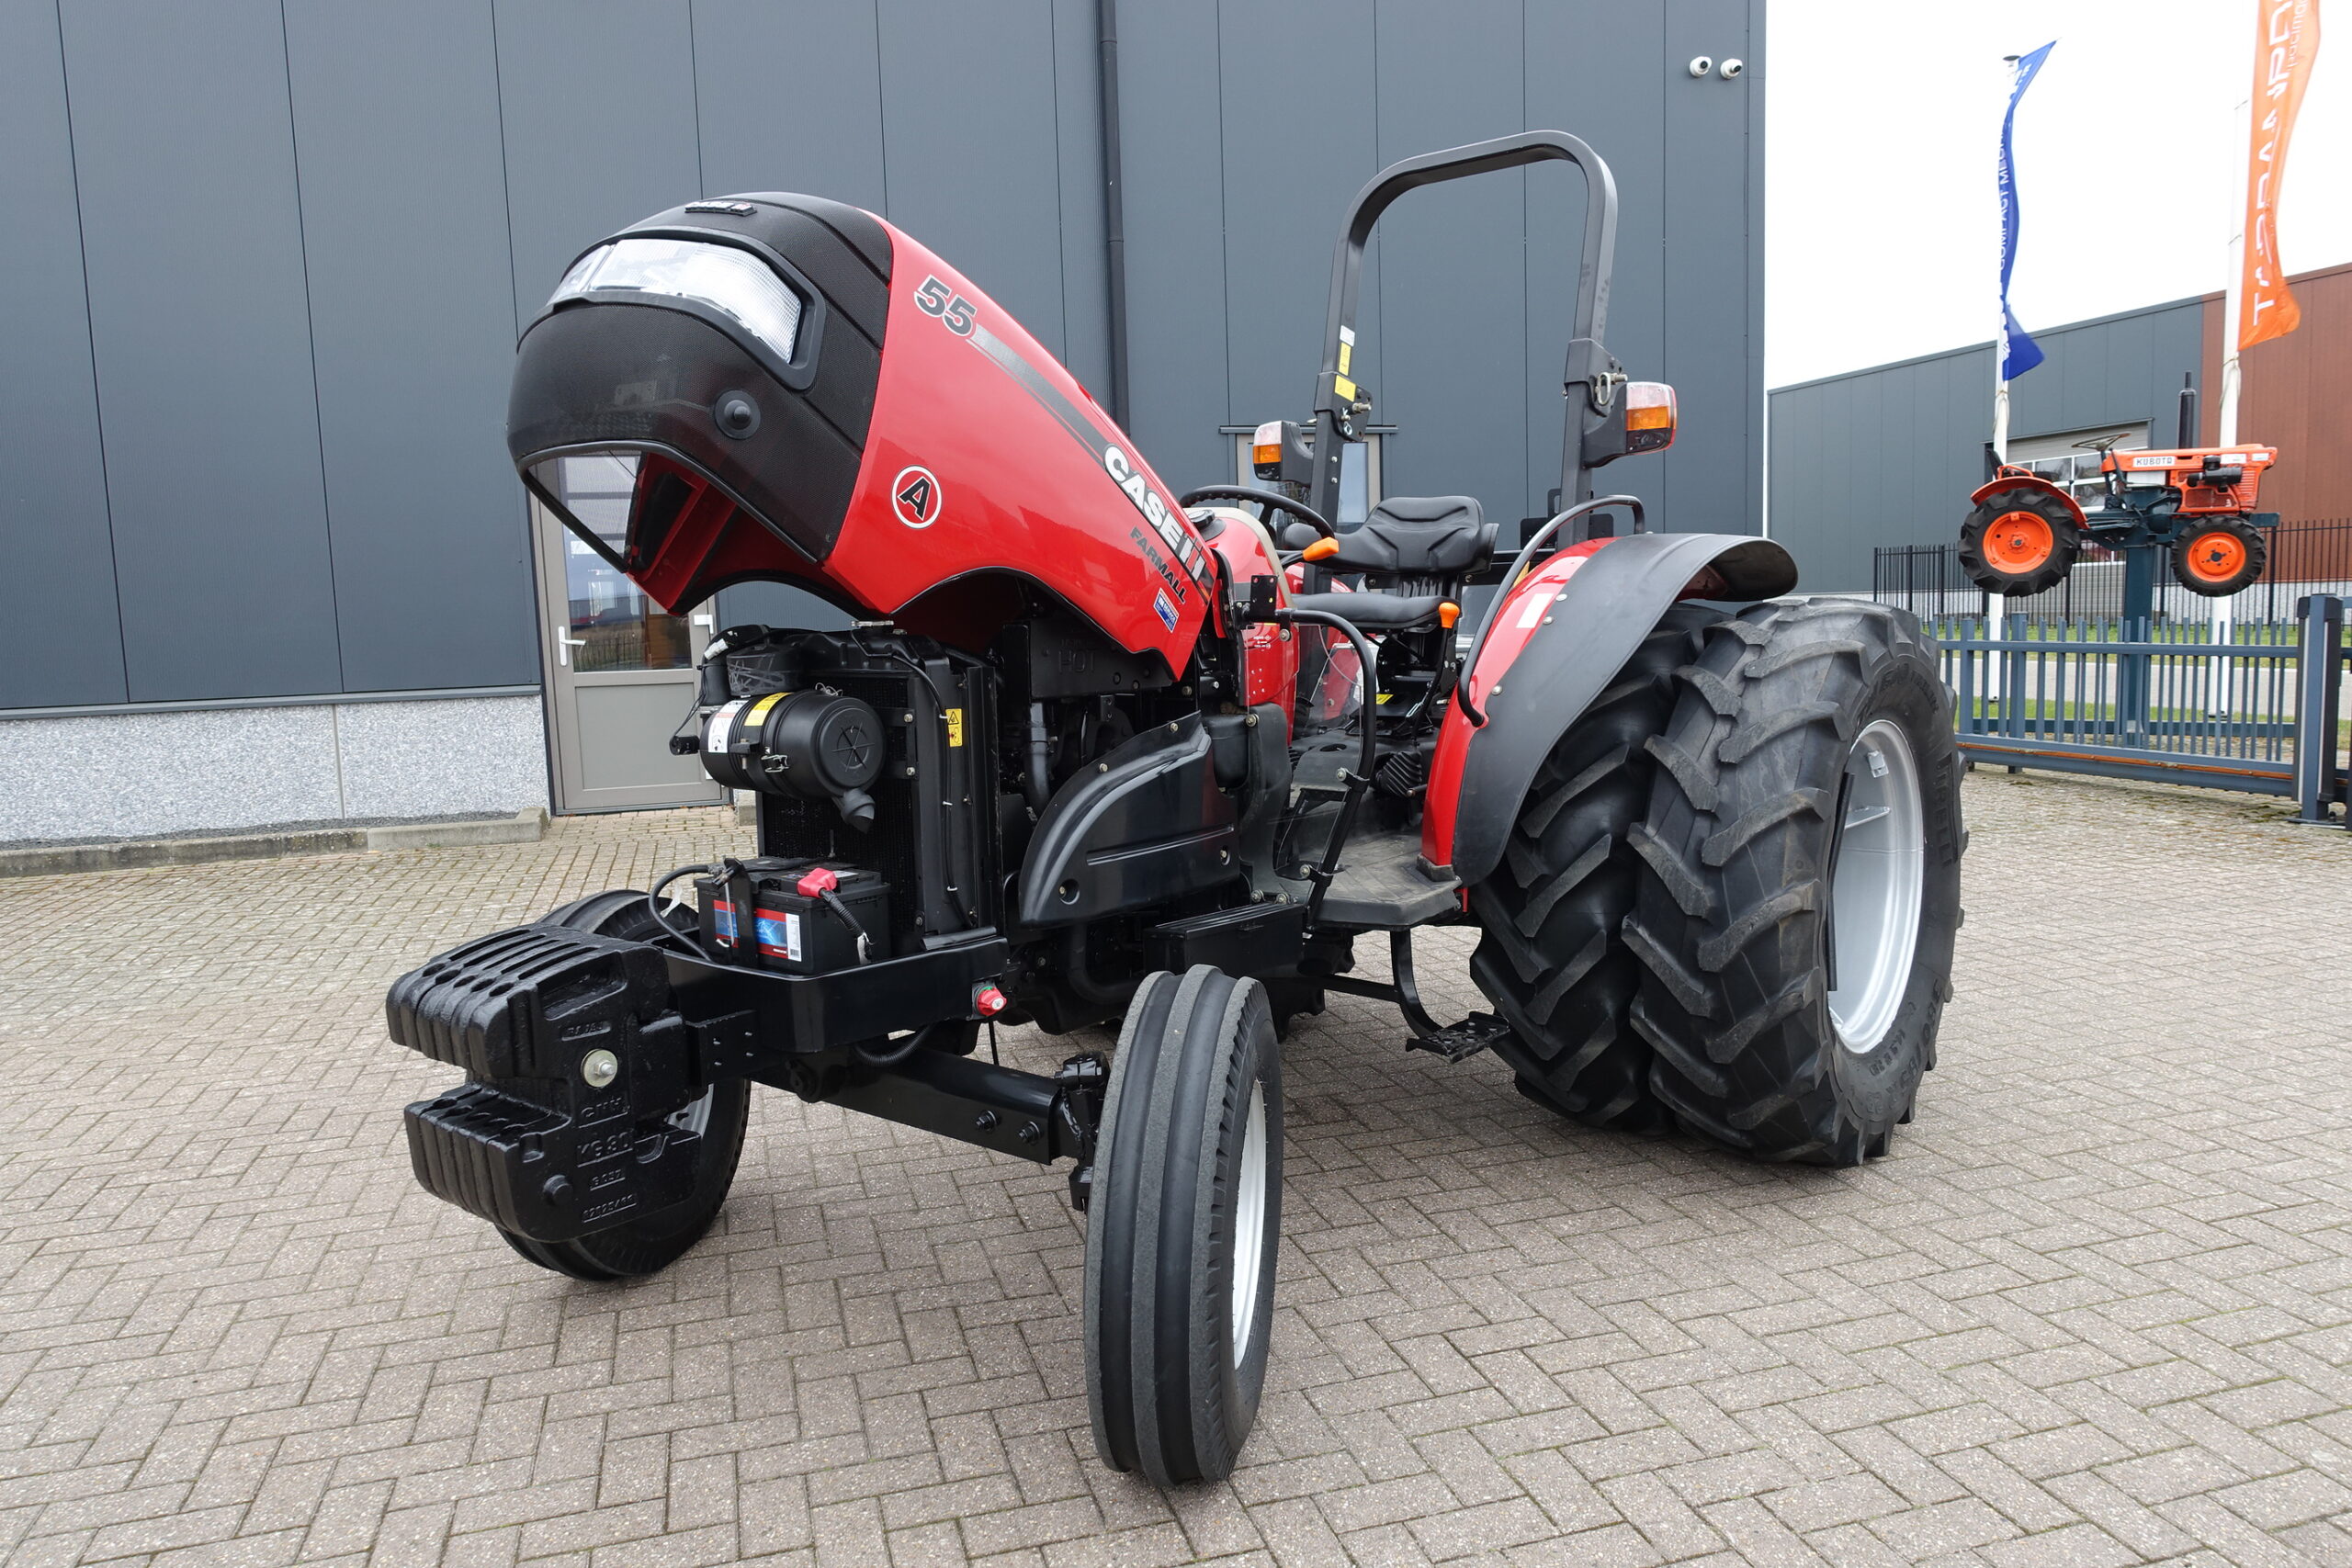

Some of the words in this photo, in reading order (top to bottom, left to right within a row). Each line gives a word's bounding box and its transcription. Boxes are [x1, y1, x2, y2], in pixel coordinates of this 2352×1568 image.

[914, 274, 978, 336] 55
[2136, 457, 2173, 466] KUBOTA
[898, 475, 931, 522] A
[1130, 526, 1188, 604] FARMALL
